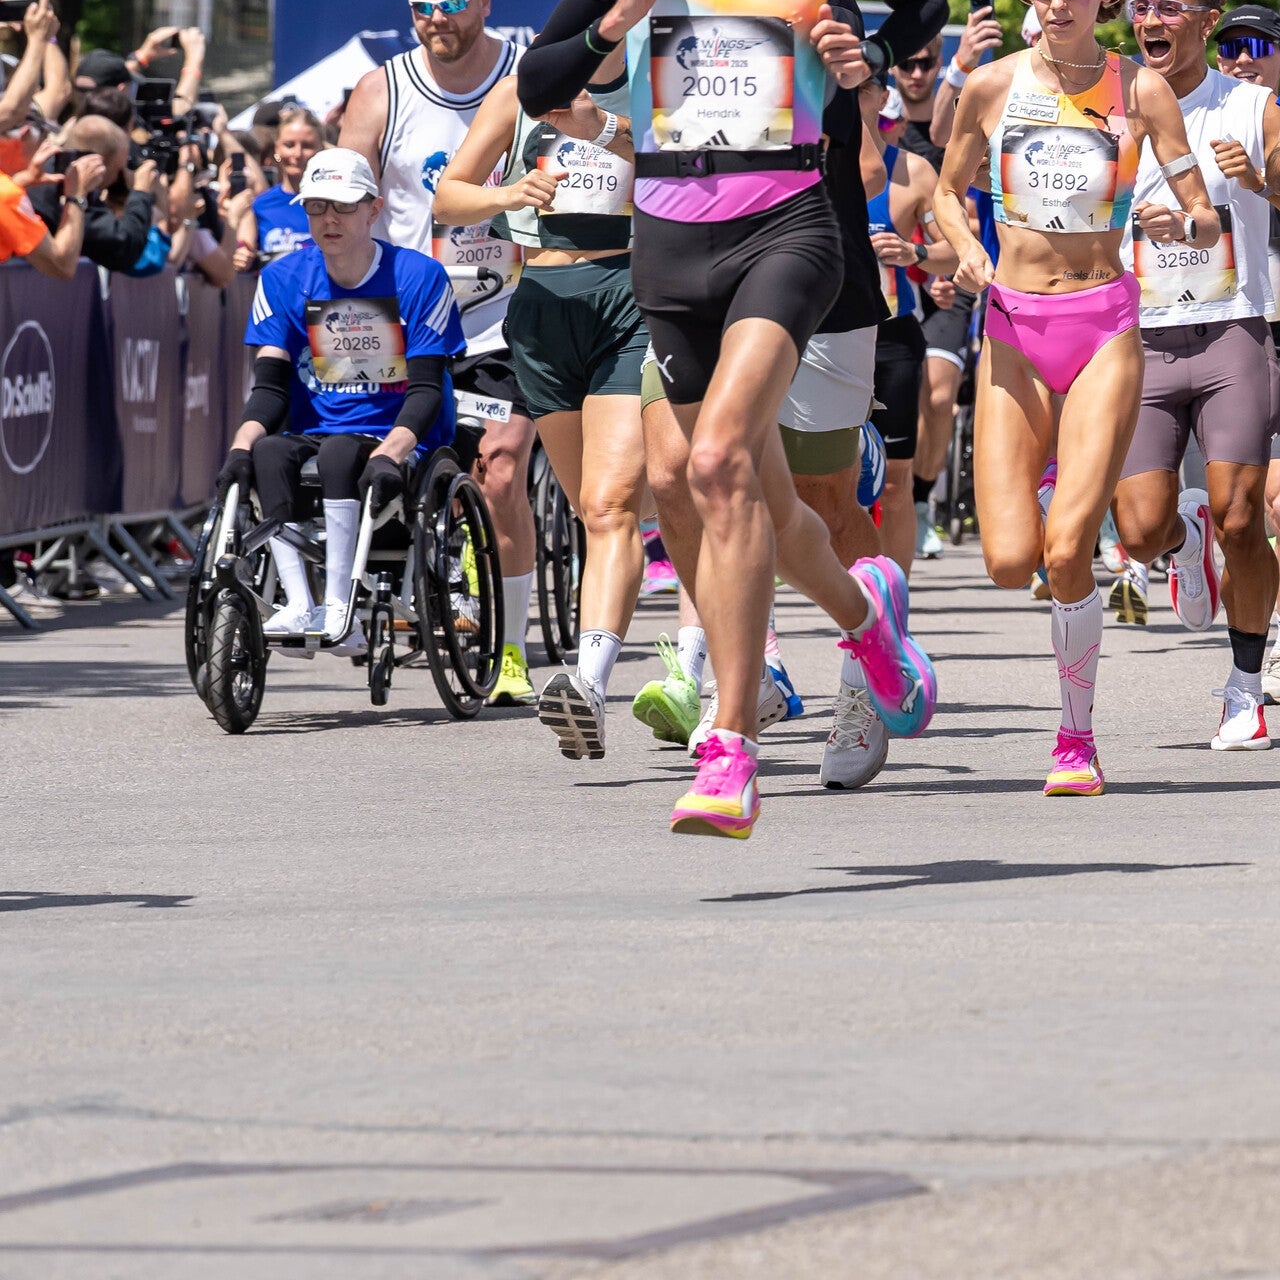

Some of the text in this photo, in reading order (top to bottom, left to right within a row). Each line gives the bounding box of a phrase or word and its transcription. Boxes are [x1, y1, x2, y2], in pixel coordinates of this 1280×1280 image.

[701, 39, 745, 49] WINGS
[682, 75, 758, 97] 20015
[697, 108, 741, 119] Hendrik
[560, 172, 618, 192] 32619
[1028, 171, 1088, 192] 31892
[1042, 198, 1071, 208] Esther
[1088, 212, 1094, 225] 1
[456, 245, 503, 263] 20073
[1157, 250, 1210, 269] 32580
[1089, 269, 1111, 279] like
[333, 336, 380, 350] 20285
